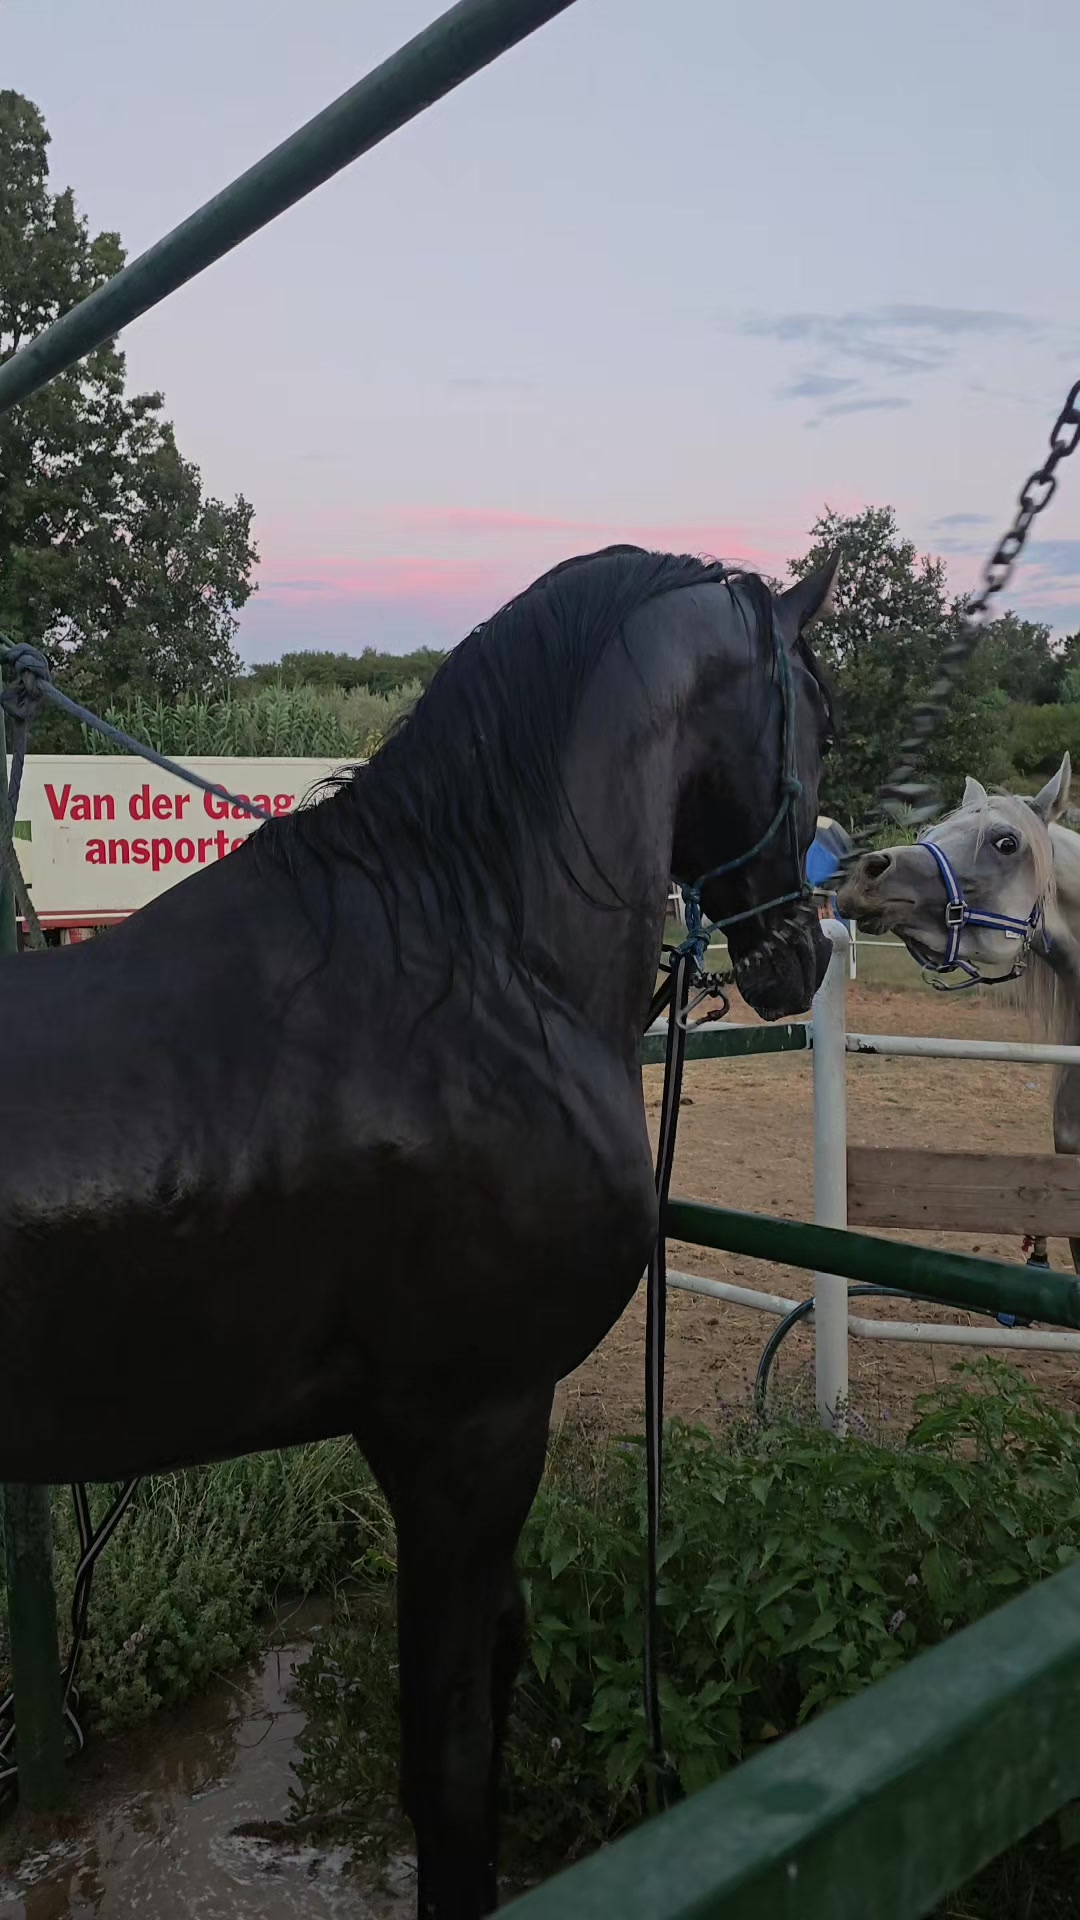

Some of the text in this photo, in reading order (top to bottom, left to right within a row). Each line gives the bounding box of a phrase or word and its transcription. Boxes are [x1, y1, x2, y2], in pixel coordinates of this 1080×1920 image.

[44, 784, 295, 821] Van der Gaag
